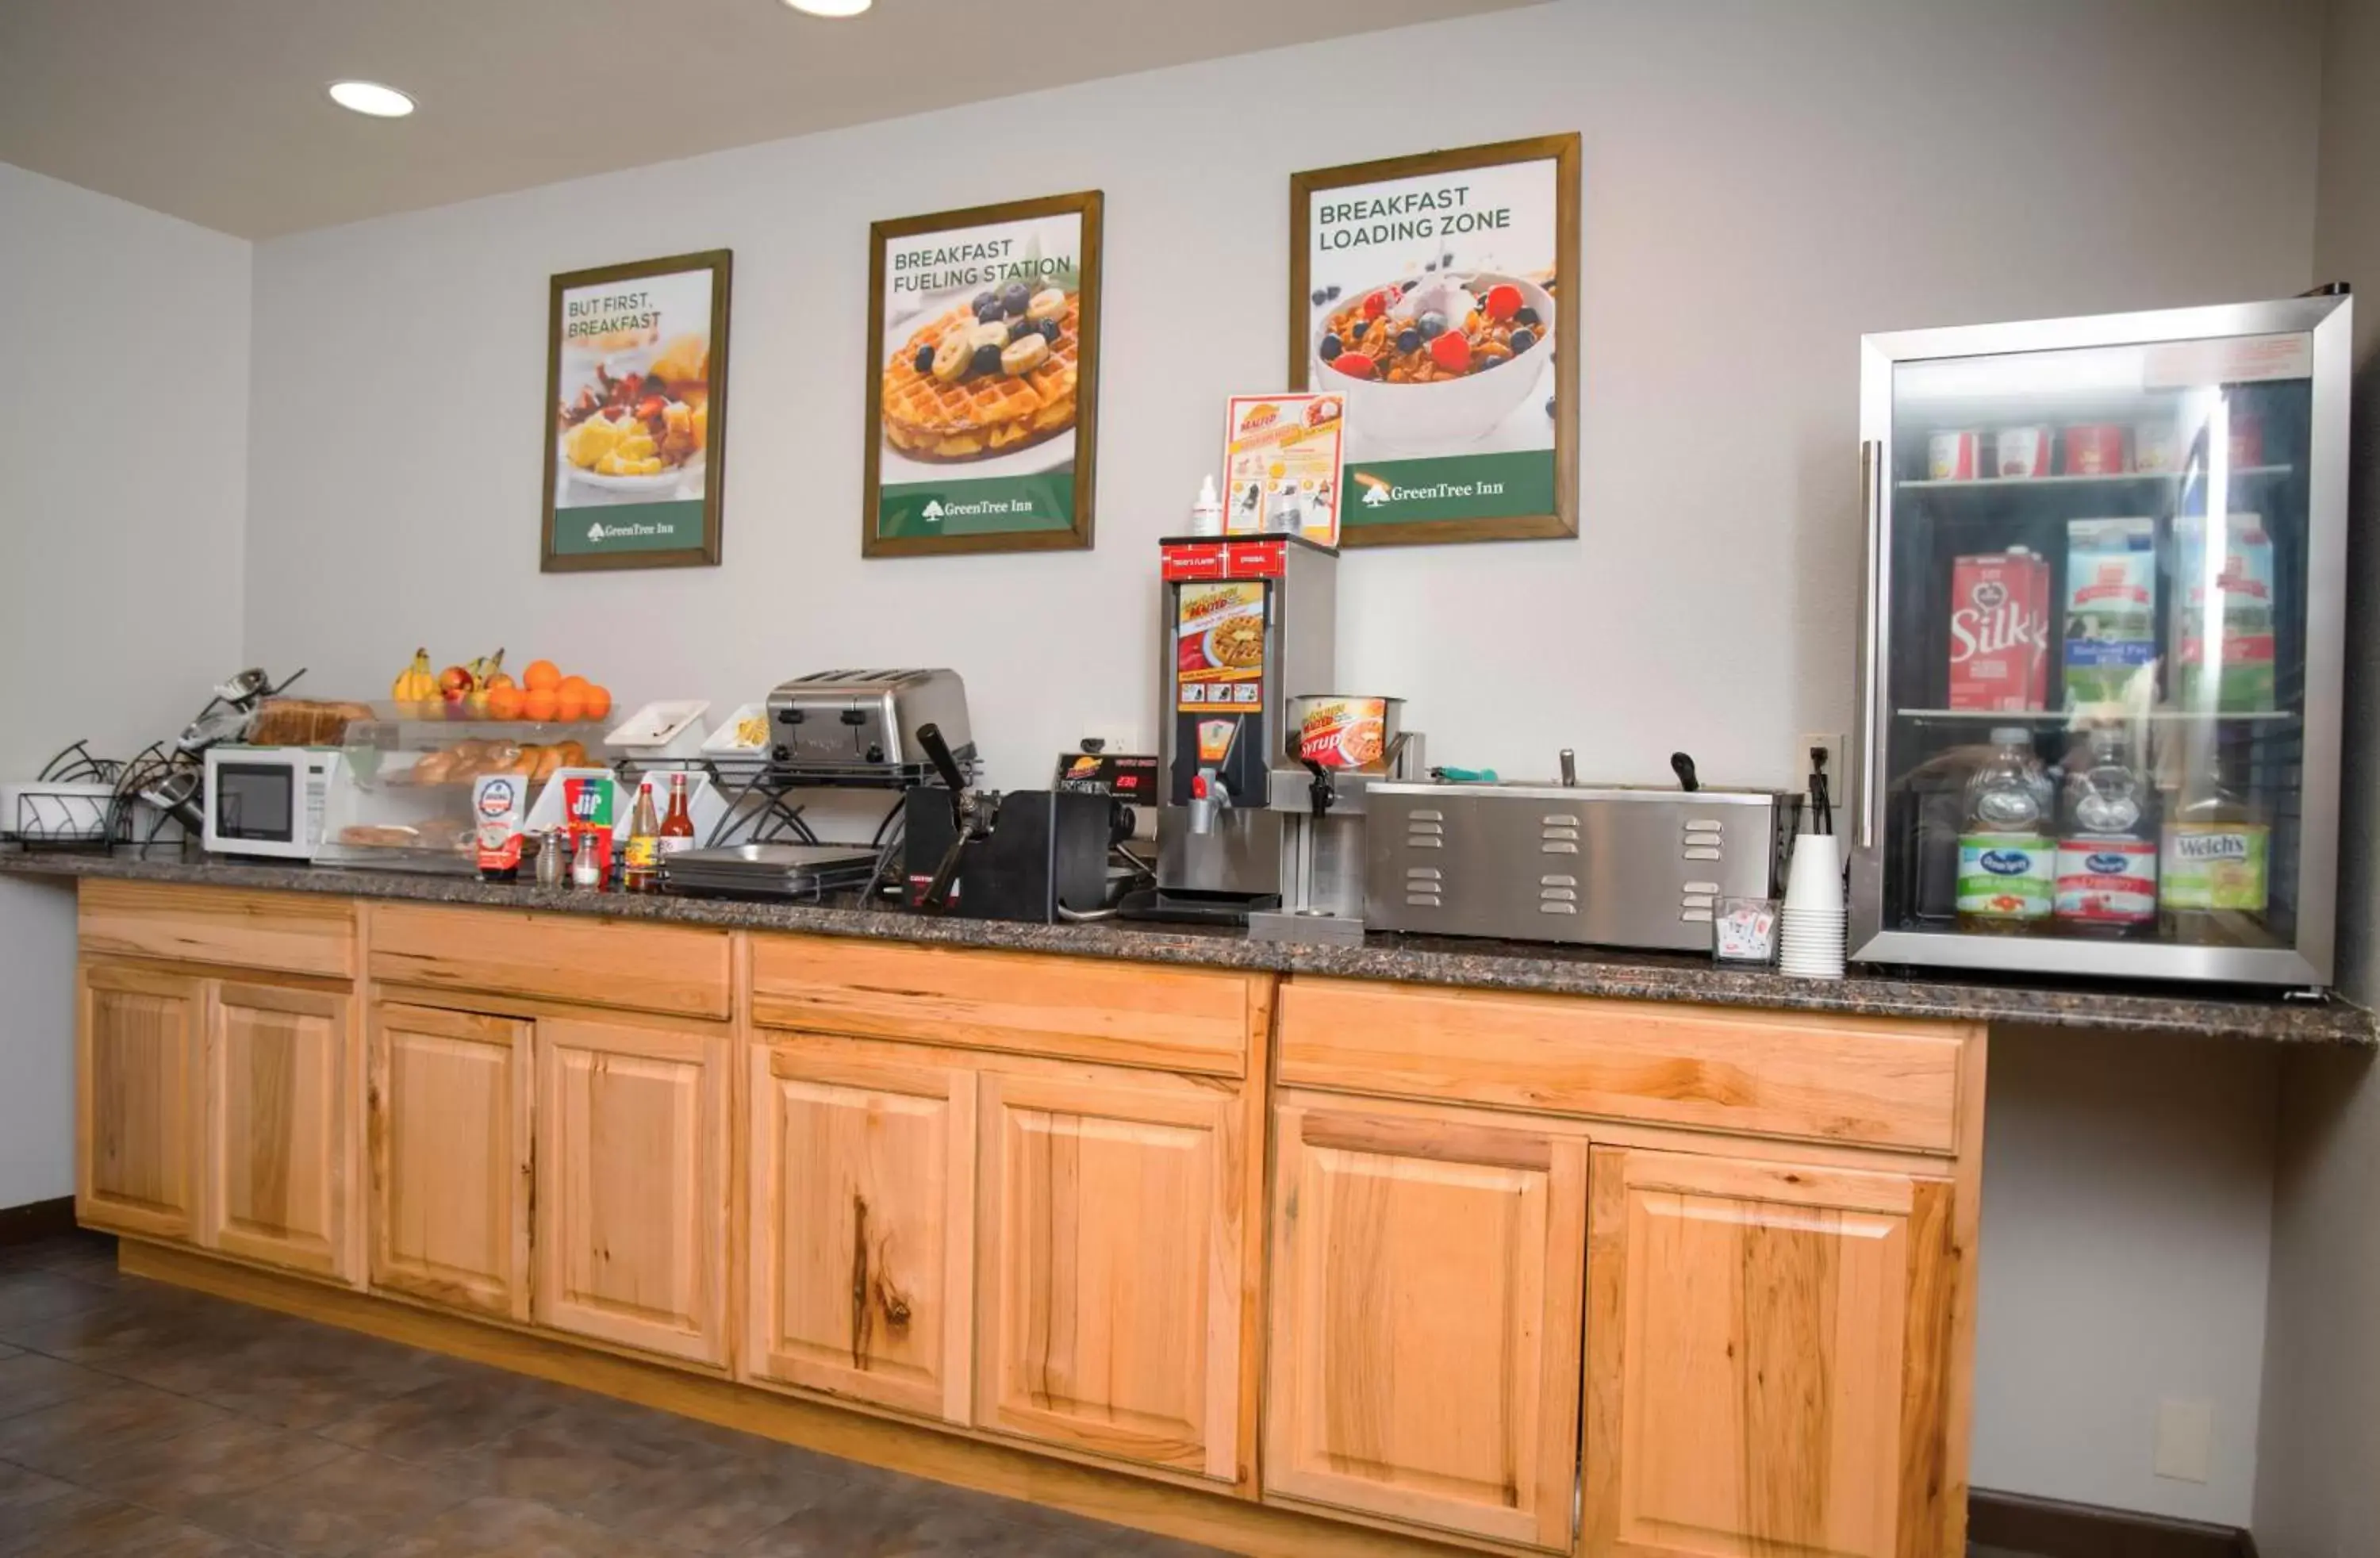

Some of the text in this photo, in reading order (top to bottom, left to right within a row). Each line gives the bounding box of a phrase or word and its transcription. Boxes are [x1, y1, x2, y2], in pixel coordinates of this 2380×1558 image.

[1320, 186, 1469, 225] BREAKFAST
[1320, 208, 1511, 251] LOADING ZONE
[895, 239, 1014, 271] BREAKFAST
[893, 255, 1071, 293] FUELING STATION
[568, 291, 653, 318] BUT FIRST,
[568, 311, 662, 338] BREAKFAST
[1390, 480, 1503, 501] GreenTree Inn
[944, 498, 1032, 516] GreenTree Inn
[605, 522, 674, 537] GreenTree Inn
[1950, 601, 2029, 663] Silk
